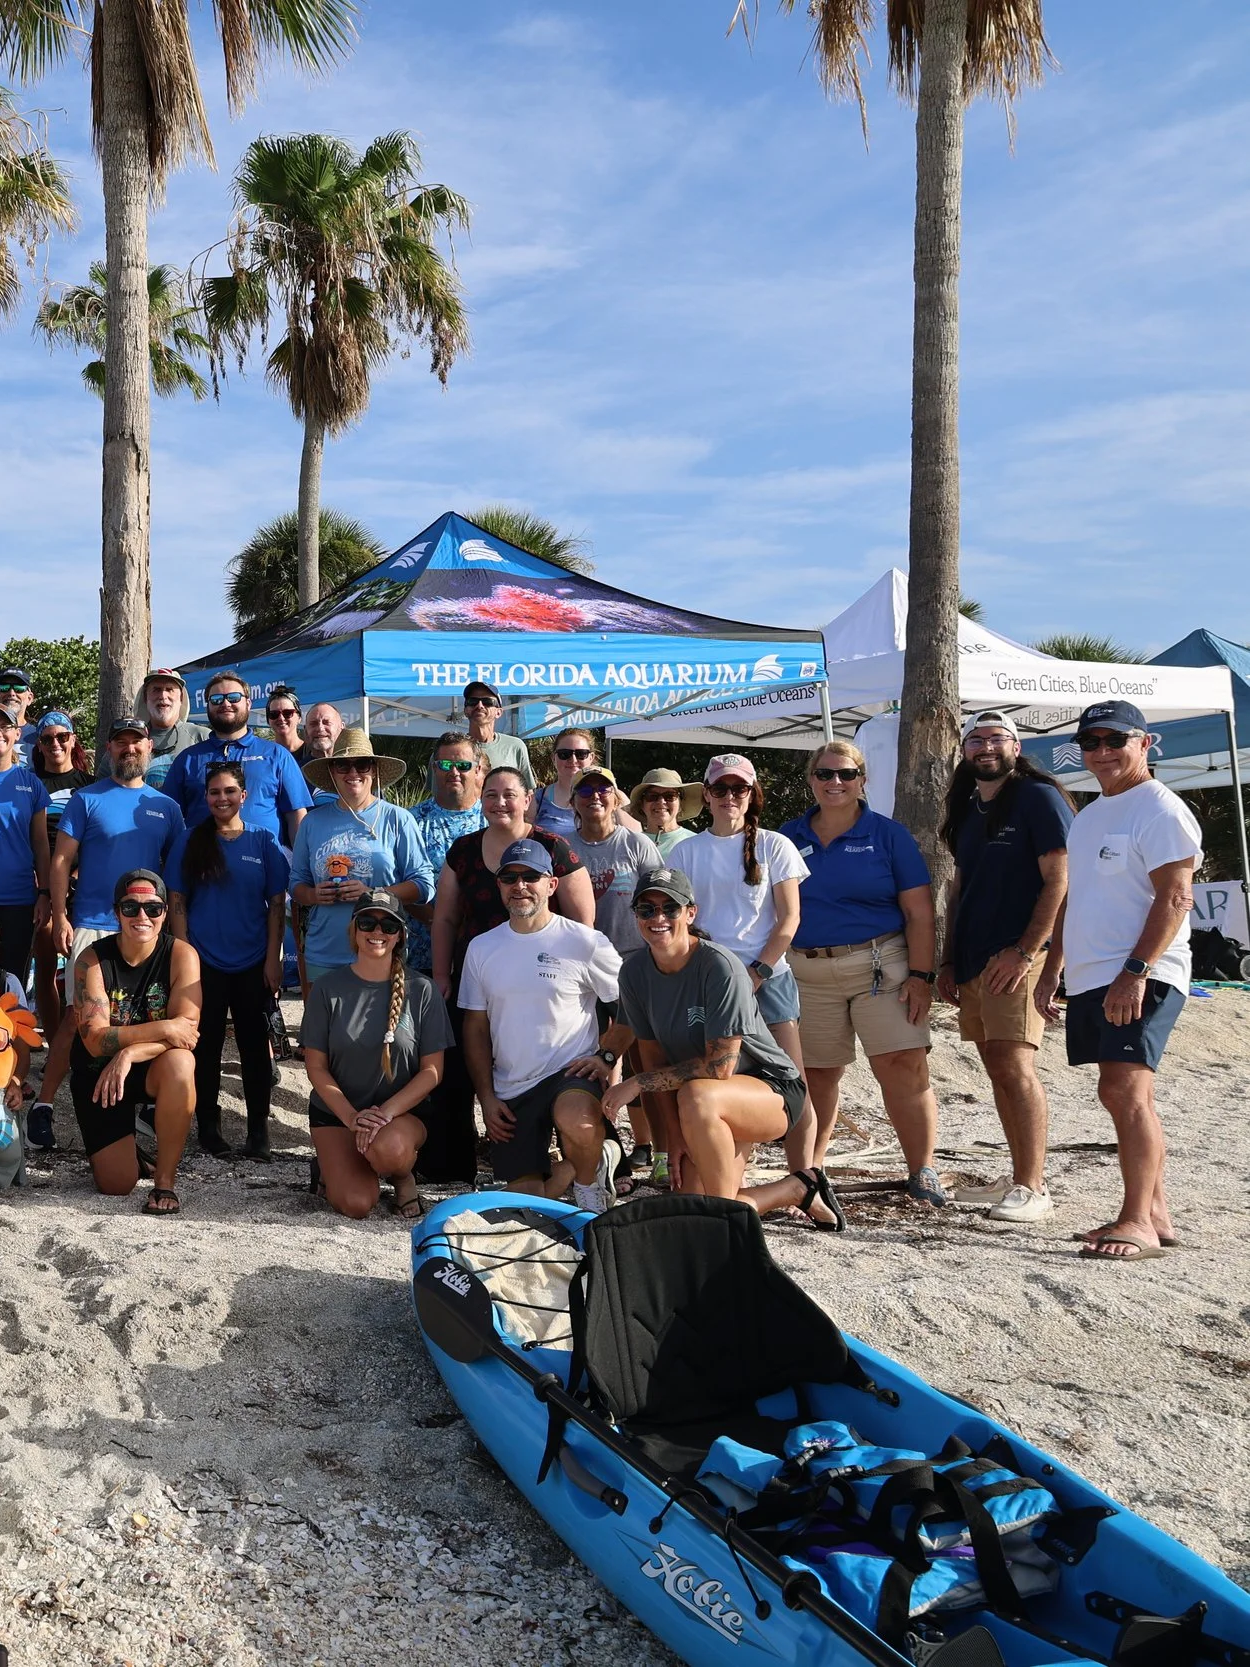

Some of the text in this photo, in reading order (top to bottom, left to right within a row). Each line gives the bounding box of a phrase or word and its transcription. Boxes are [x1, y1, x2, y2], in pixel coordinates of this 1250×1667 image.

[411, 663, 747, 689] THE FLORIDA AQUARIUM
[1039, 674, 1078, 695] Cities,
[1080, 676, 1107, 694] Blue
[538, 972, 558, 980] STAFF
[433, 1262, 472, 1297] Hobie
[640, 1542, 744, 1646] Hobie
